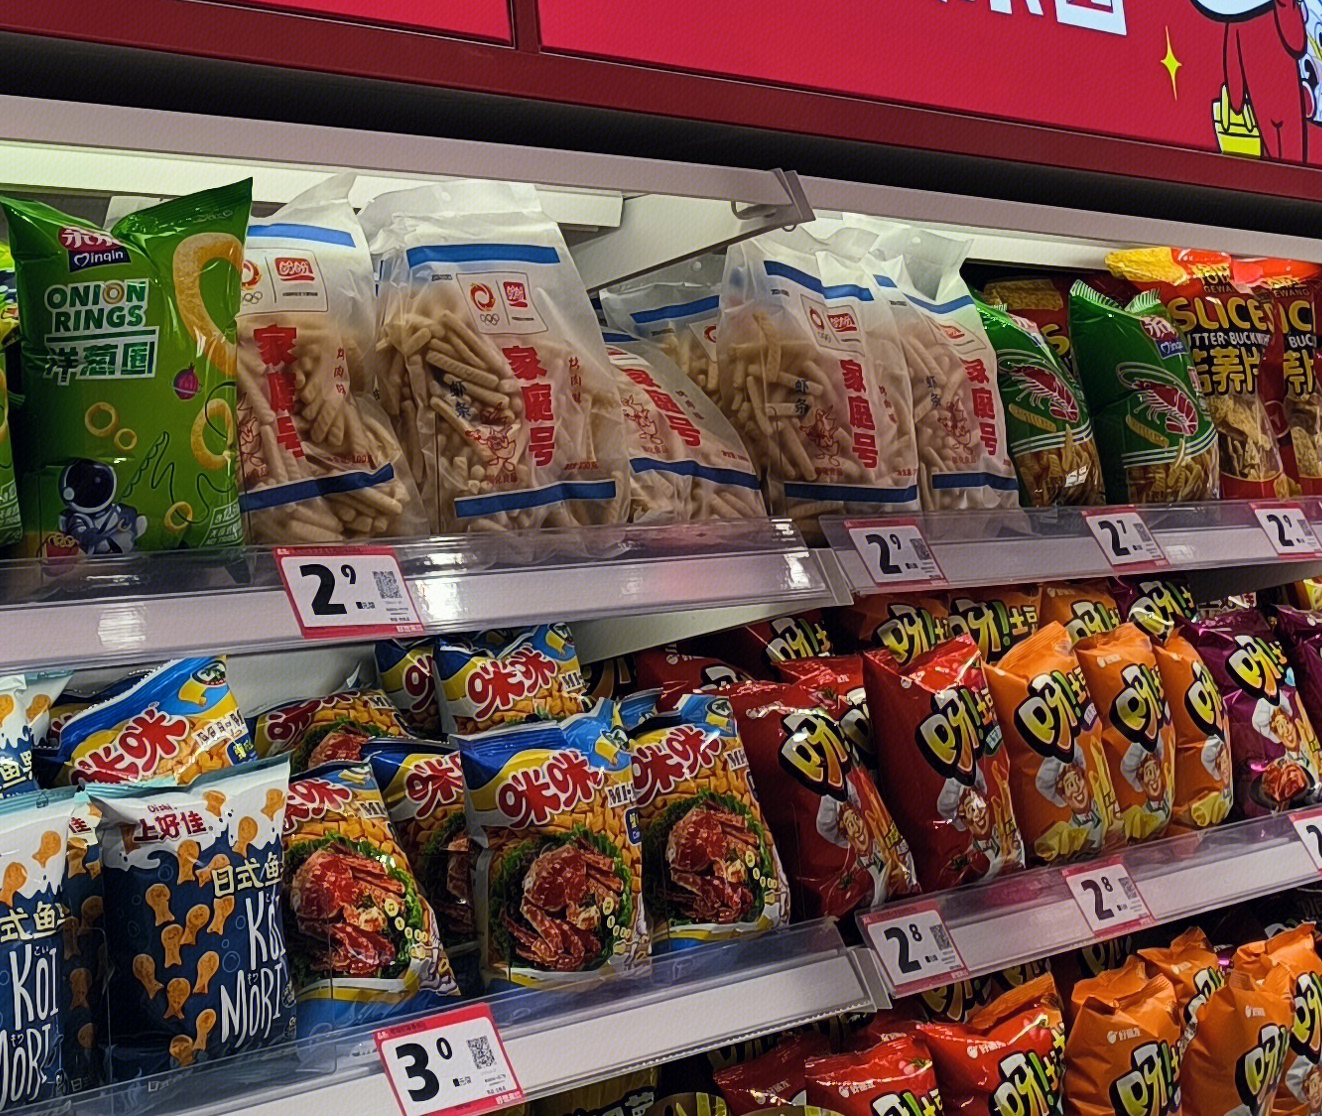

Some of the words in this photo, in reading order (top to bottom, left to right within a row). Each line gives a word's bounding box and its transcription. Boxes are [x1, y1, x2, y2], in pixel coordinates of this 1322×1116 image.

[46, 280, 147, 310] ONION
[53, 307, 144, 333] RINGS
[44, 342, 156, 384] 洋葱圈
[253, 323, 305, 458] 家庭号
[502, 345, 558, 467] 家庭号
[623, 368, 701, 447] 家庭号
[794, 378, 809, 415] 虾条
[840, 359, 879, 469] 家庭号
[960, 358, 997, 456] 家庭号
[865, 534, 902, 574] 2
[1098, 521, 1131, 556] 2
[1266, 514, 1294, 547] 2
[299, 563, 347, 615] 2
[340, 564, 357, 584] 9
[467, 644, 557, 720] 咪咪
[498, 750, 605, 829] 咪咪
[632, 724, 721, 805] 咪咪
[134, 810, 205, 841] 上好佳
[246, 890, 286, 970] KOI
[1082, 879, 1114, 920] 2
[884, 926, 921, 974] 2
[909, 924, 922, 942] 8
[9, 944, 59, 1031] KOI
[220, 963, 283, 1045] MORI
[395, 1043, 439, 1102] 3
[436, 1037, 452, 1060] 0
